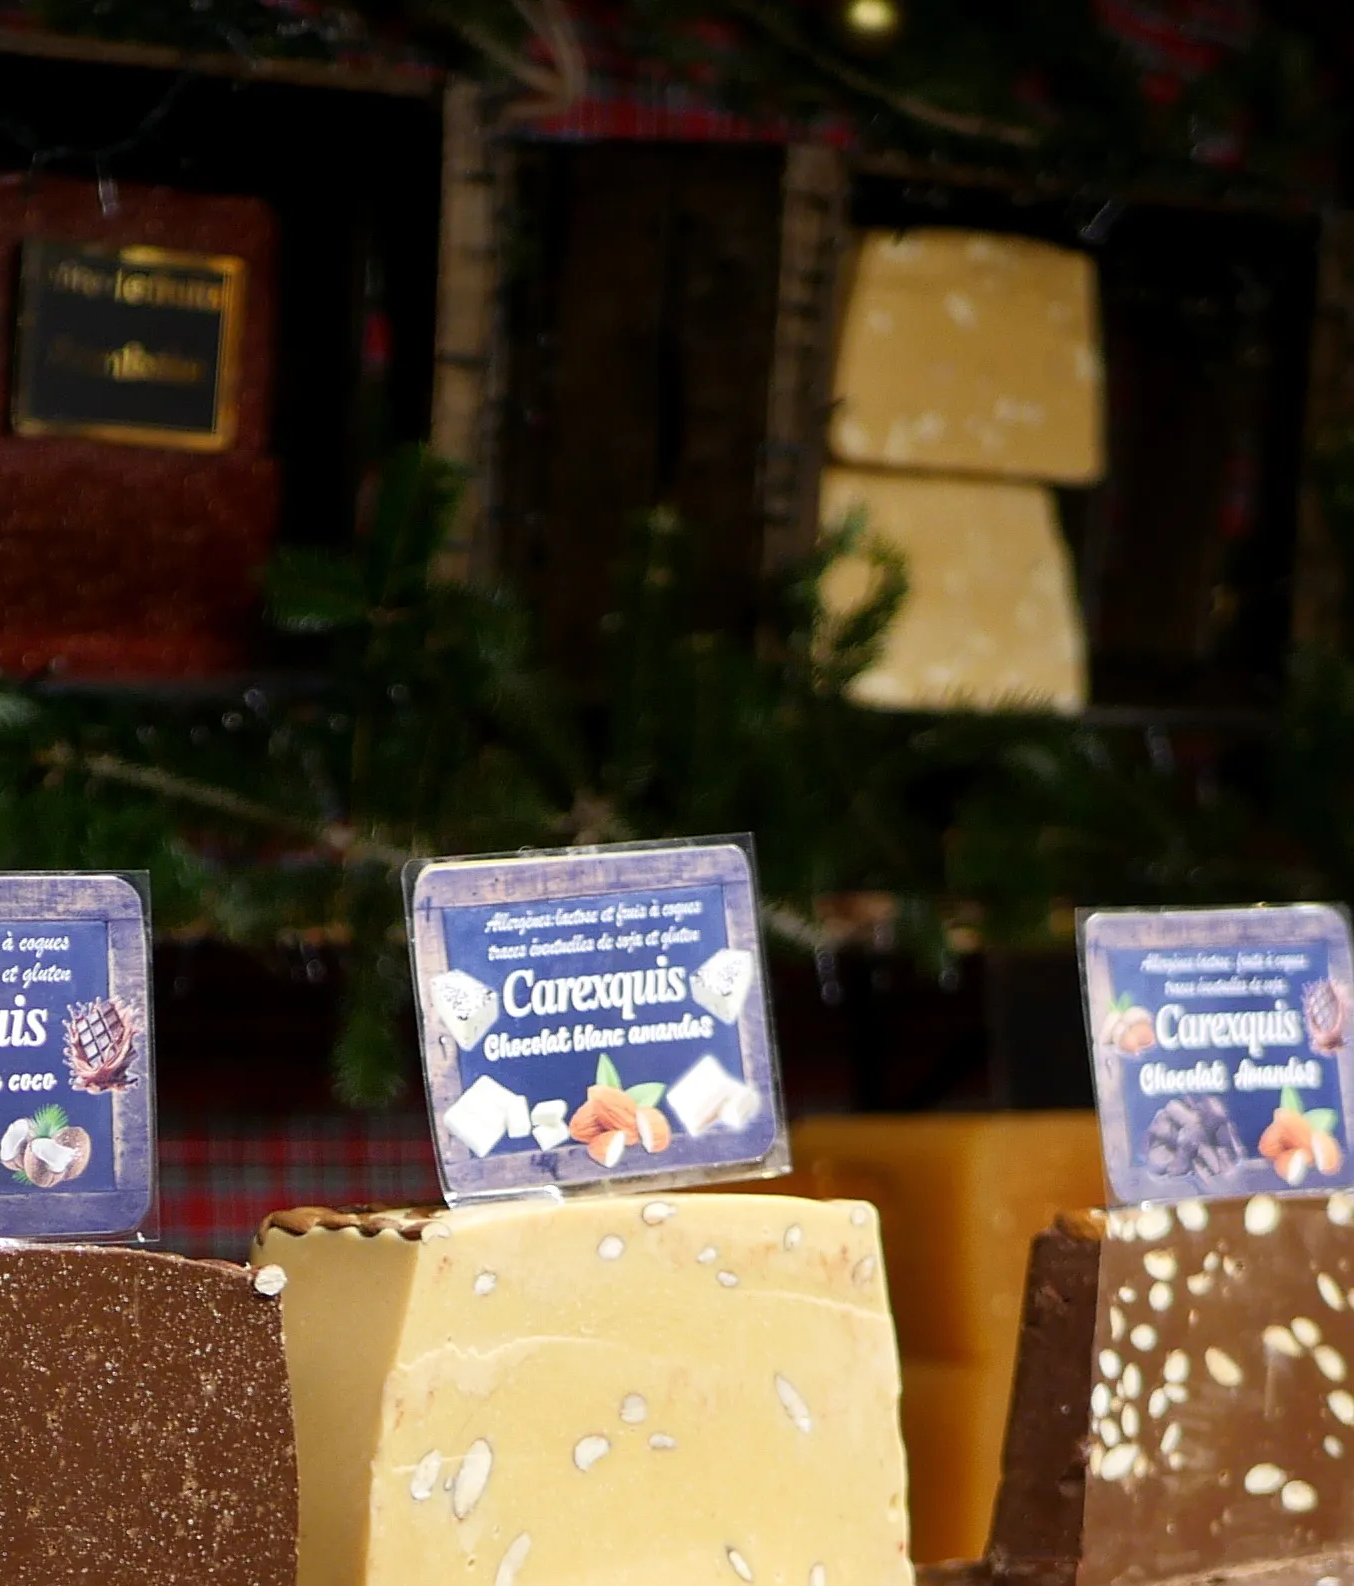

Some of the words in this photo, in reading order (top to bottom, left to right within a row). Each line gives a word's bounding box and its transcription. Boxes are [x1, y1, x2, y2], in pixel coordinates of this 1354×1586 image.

[600, 906, 615, 923] et
[649, 899, 660, 918] à
[661, 901, 703, 923] coques
[2, 931, 14, 951] à
[19, 935, 70, 958] coques
[488, 944, 527, 961] traces
[529, 934, 595, 958] éventuelles
[597, 933, 614, 950] de
[615, 931, 644, 953] soja
[645, 930, 660, 946] et
[660, 926, 701, 950] gluten
[2, 964, 17, 983] et
[22, 962, 72, 988] gluten
[503, 955, 687, 1020] Carexquis
[484, 1025, 573, 1062] Chocolat
[573, 1023, 626, 1052] blanc
[628, 1013, 715, 1044] amandes
[1156, 999, 1303, 1058] Carexquis
[8, 1072, 58, 1092] coco
[1139, 1060, 1228, 1095] Chocolat
[1234, 1056, 1322, 1091] Amandes
